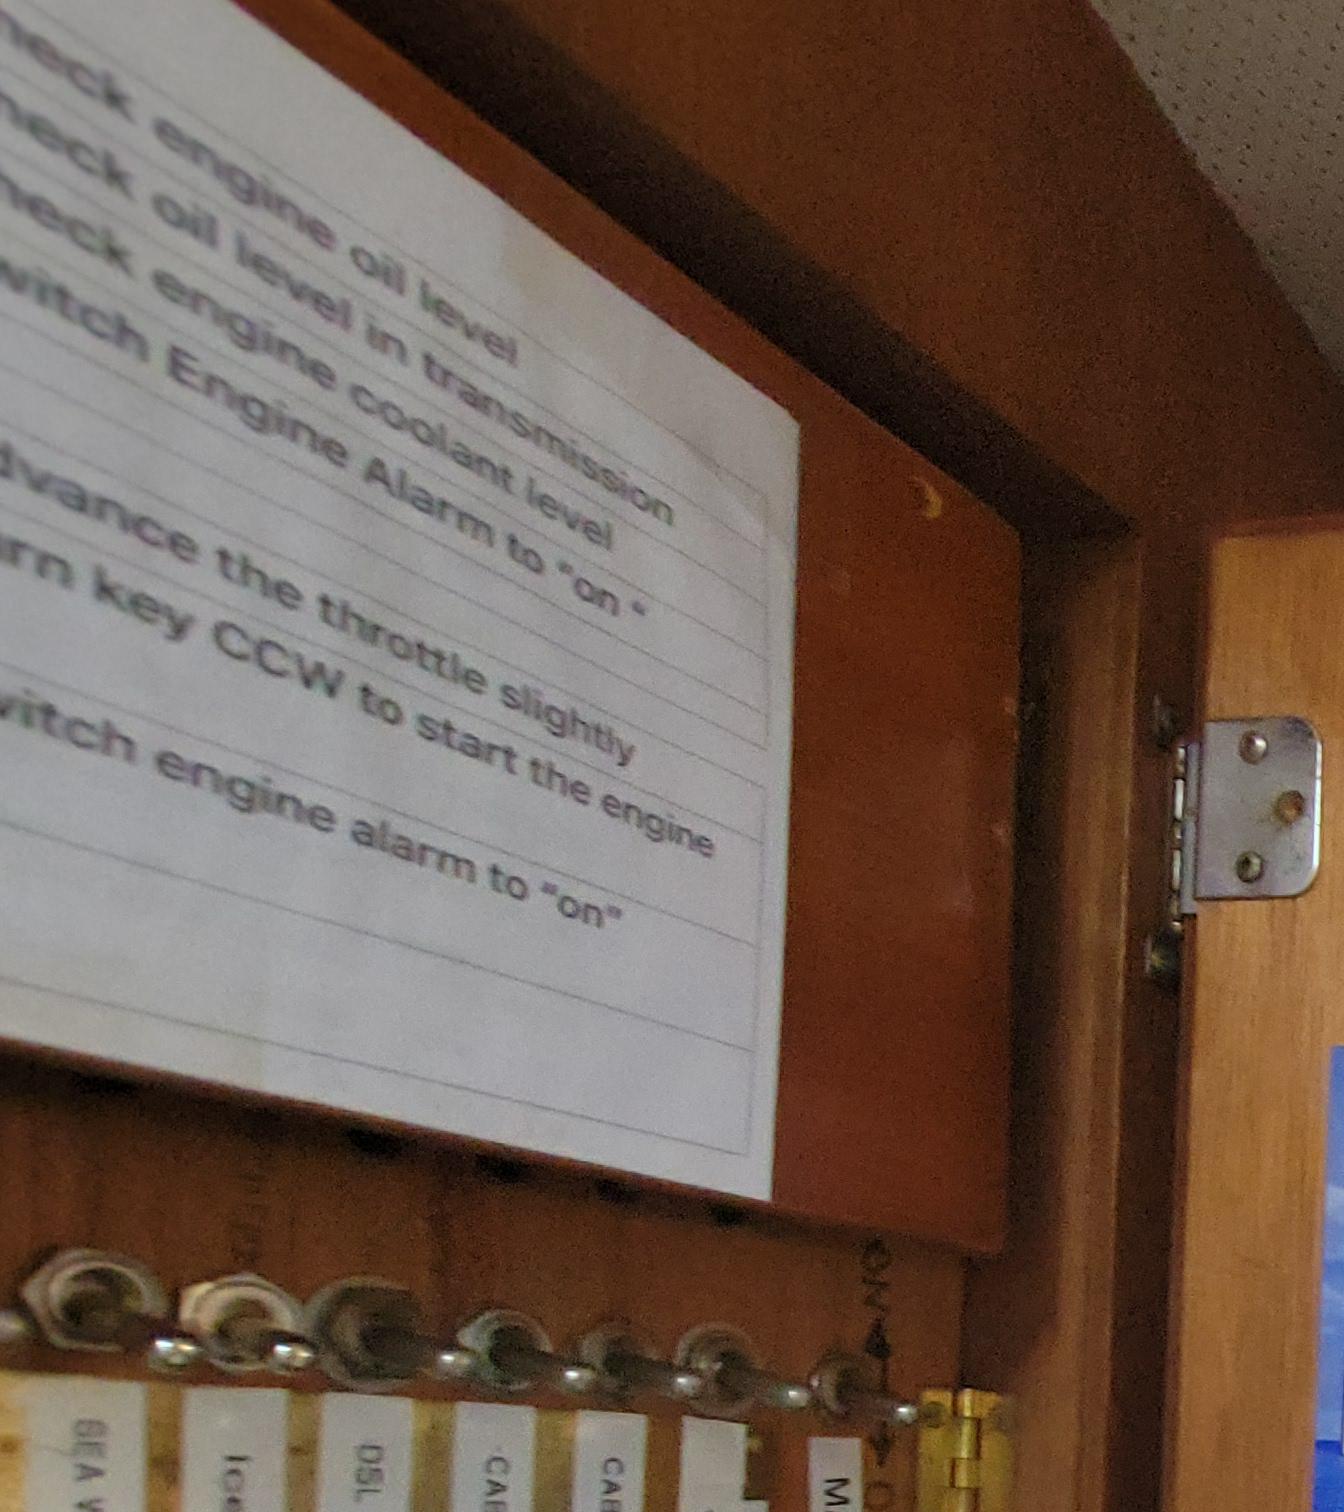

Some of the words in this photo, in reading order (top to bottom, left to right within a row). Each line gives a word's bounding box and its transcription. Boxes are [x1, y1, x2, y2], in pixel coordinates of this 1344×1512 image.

[152, 117, 336, 250] engine
[350, 246, 404, 295] oil
[420, 280, 518, 367] level
[152, 193, 217, 249] oil
[235, 230, 352, 333] level
[365, 313, 408, 366] in
[421, 352, 676, 527] transmission
[152, 268, 337, 391] engine
[349, 383, 514, 495] coolant
[526, 476, 613, 550] level
[166, 345, 348, 468] Engine
[363, 456, 494, 548] Alarm
[506, 533, 547, 576] to
[93, 564, 195, 643] key
[211, 618, 346, 699] CCW
[357, 682, 404, 727] to
[415, 712, 520, 776] start
[530, 755, 592, 806] the
[600, 793, 716, 860] engine
[216, 546, 303, 611] the
[318, 592, 488, 696] throttle
[500, 683, 637, 767] slightly
[155, 748, 338, 833] engine
[351, 819, 478, 884] alarm
[488, 862, 530, 902] to
[351, 1443, 386, 1503] DSL
